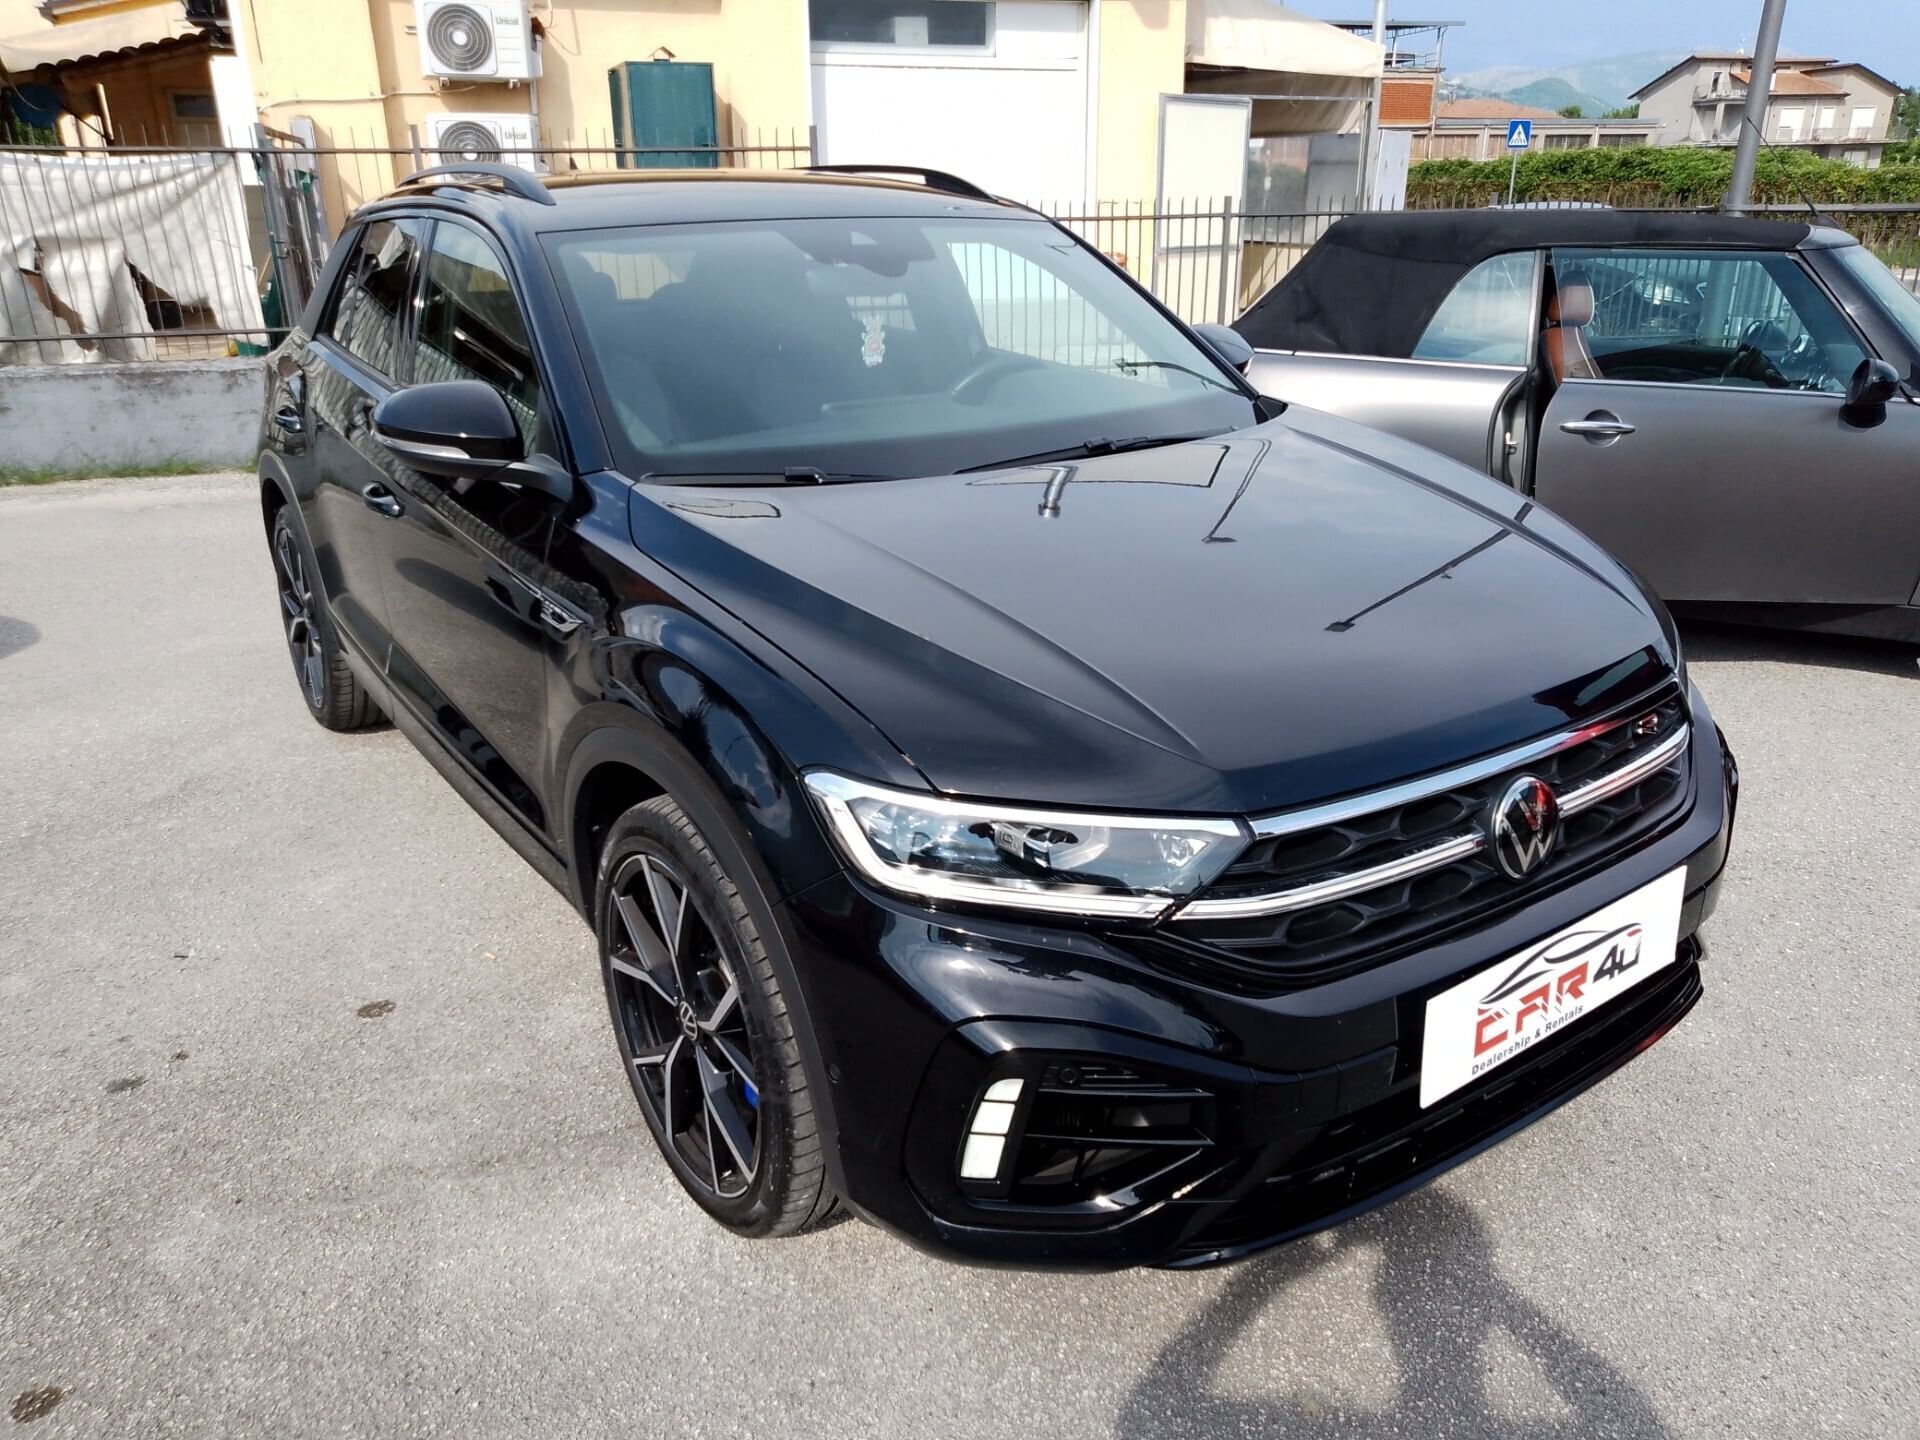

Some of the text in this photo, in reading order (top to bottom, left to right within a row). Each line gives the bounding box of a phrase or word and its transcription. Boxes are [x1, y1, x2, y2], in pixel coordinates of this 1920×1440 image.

[1471, 1005, 1584, 1076] Dealership & Rentals
[1473, 961, 1590, 1058] CAR
